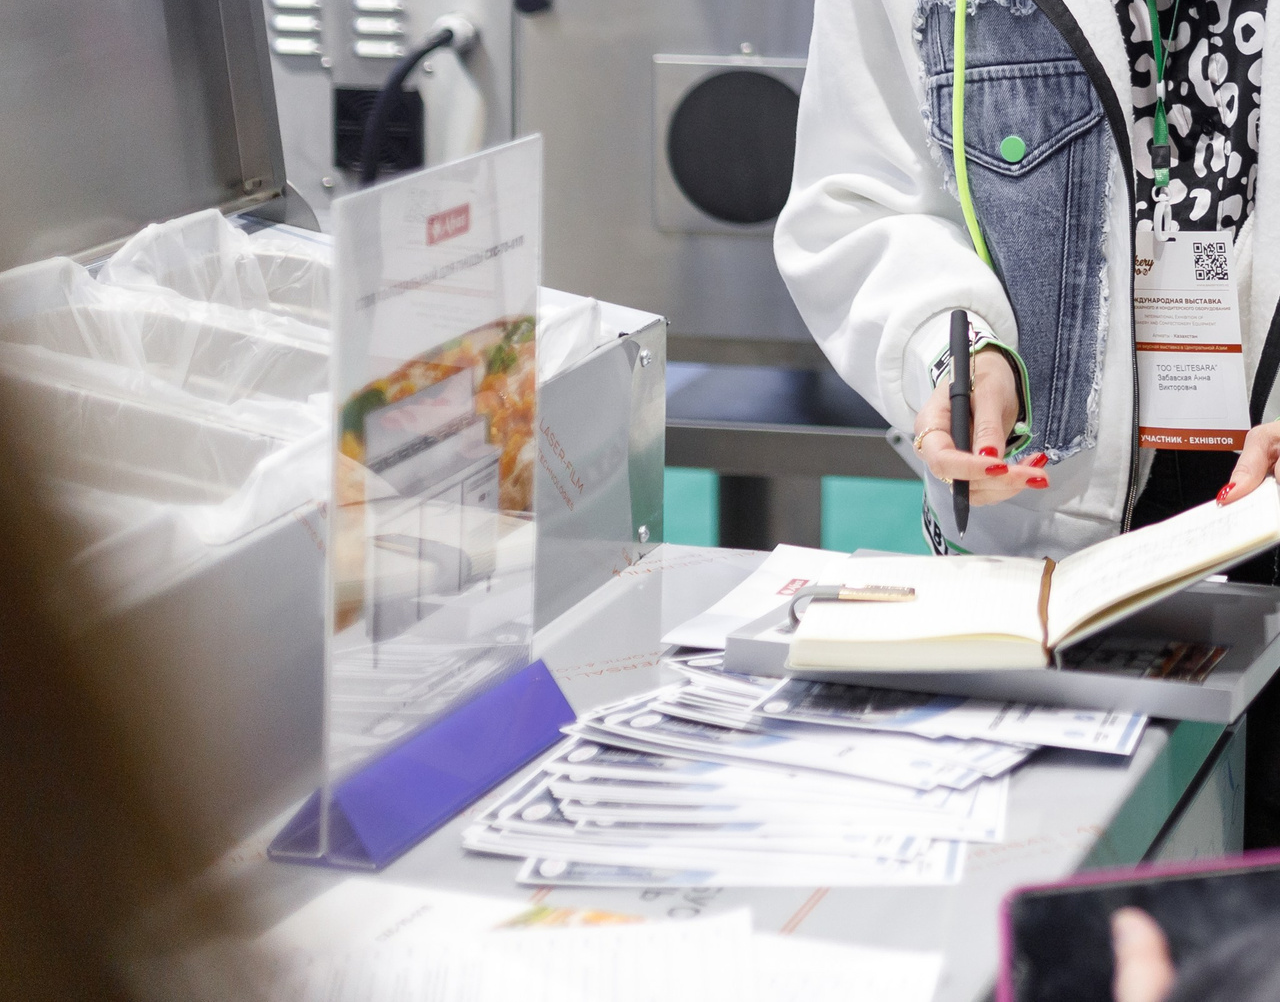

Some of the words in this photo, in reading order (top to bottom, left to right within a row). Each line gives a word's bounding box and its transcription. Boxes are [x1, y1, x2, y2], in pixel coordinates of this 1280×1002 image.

[1159, 384, 1197, 392] Викторовна
[1141, 435, 1182, 444] УЧАСТНИК
[1189, 436, 1234, 445] EXHIBITOR
[539, 418, 584, 495] LASER-FILM
